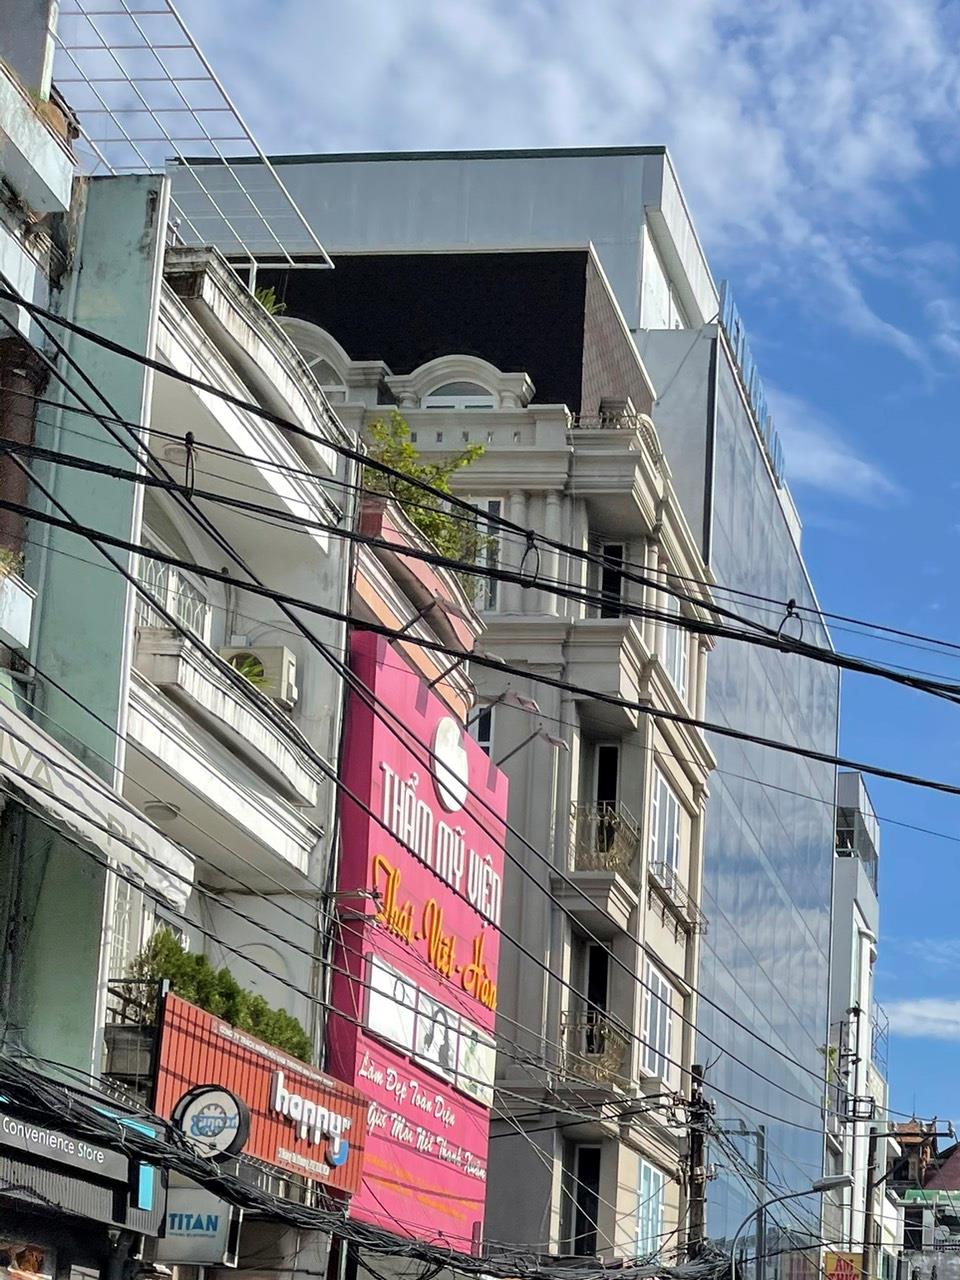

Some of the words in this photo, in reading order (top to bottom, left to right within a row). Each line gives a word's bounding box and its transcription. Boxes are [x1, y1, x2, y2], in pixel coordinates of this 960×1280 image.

[379, 761, 434, 868] THẨM
[436, 821, 465, 894] MỸ
[357, 1050, 384, 1085] Làm
[3, 1117, 75, 1154] Convenience
[78, 1143, 104, 1163] Store
[272, 1070, 349, 1166] happy
[169, 1213, 218, 1231] TITAN
